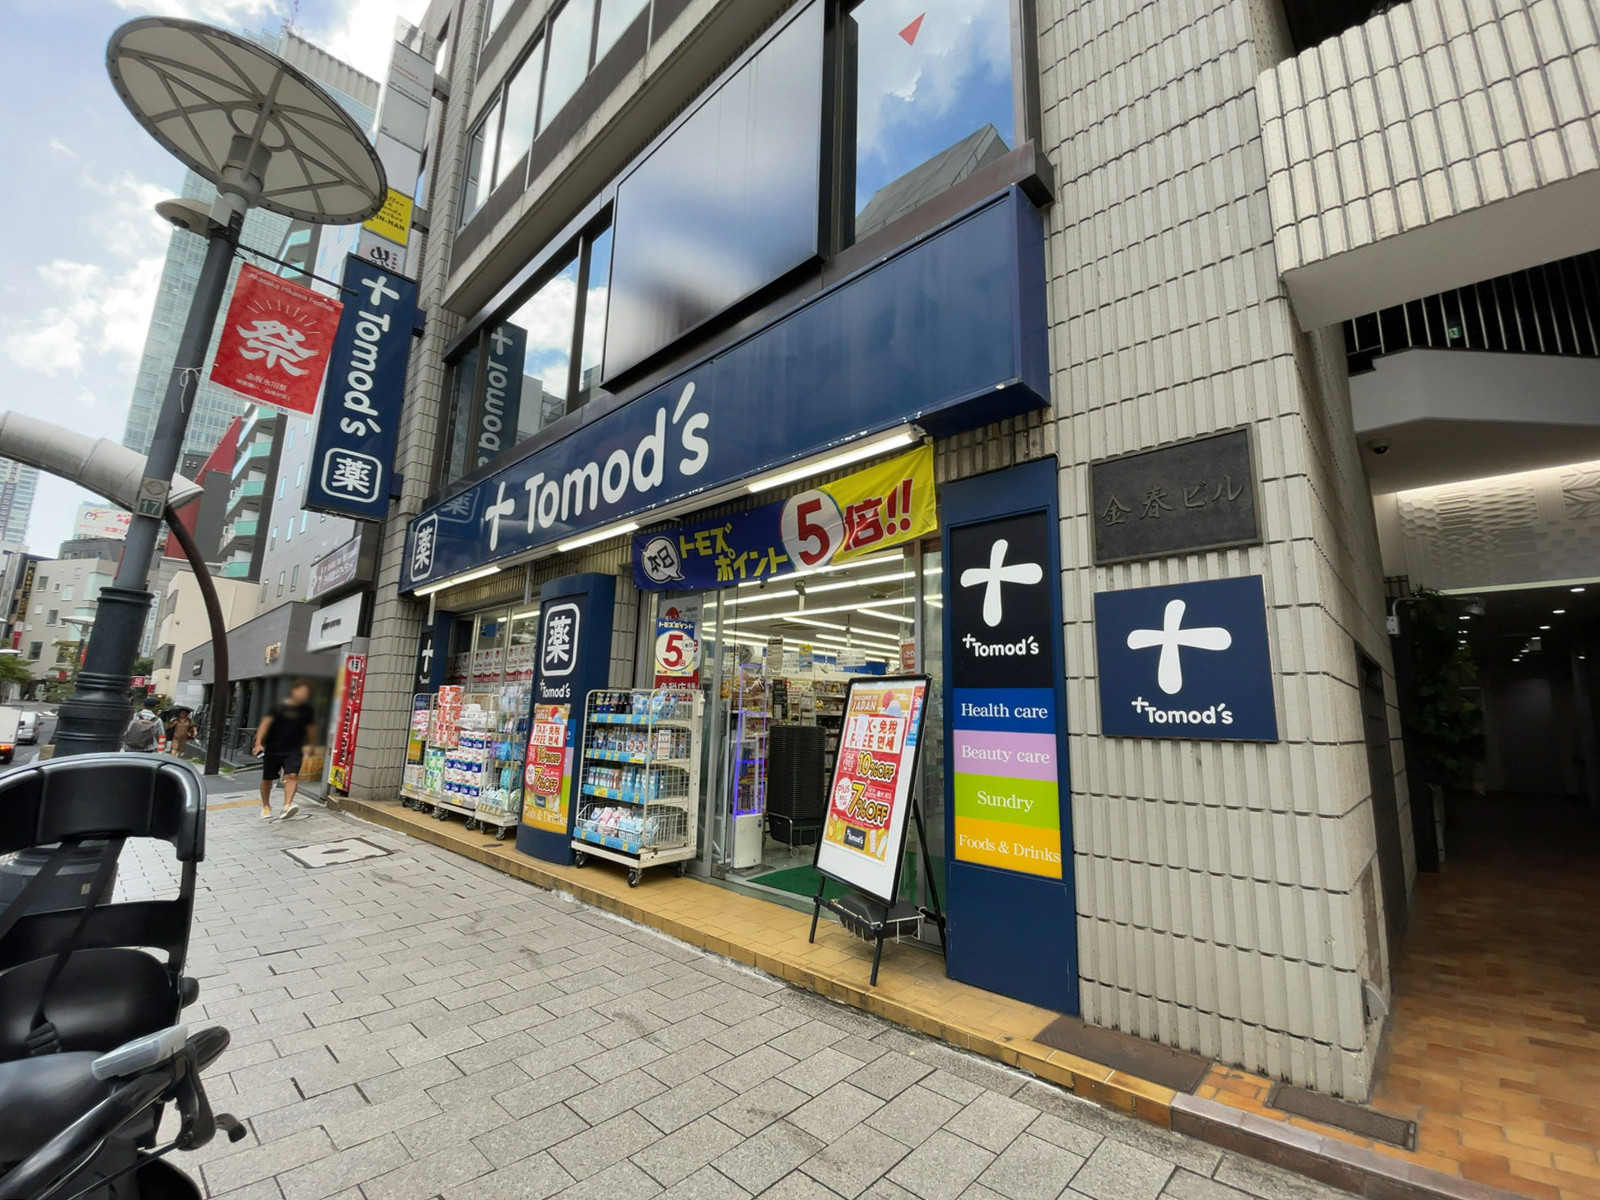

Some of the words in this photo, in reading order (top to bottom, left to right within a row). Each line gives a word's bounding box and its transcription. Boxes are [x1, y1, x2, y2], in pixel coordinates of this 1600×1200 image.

[236, 320, 320, 377] 祭
[340, 309, 391, 437] Tomod's
[525, 382, 710, 534] Tomod's
[332, 457, 373, 495] 薬
[142, 500, 160, 514] 17
[1102, 474, 1244, 527] 金春ビル
[414, 526, 433, 570] 薬
[680, 521, 732, 559] トモズ
[715, 547, 788, 582] ポイント
[546, 615, 572, 664] 薬
[973, 636, 1039, 657] Tomod's
[542, 682, 571, 698] Tomod's
[852, 701, 877, 711] JAPAN
[961, 703, 1009, 718] Health
[1014, 706, 1048, 719] care
[1145, 703, 1233, 725] Tomod's
[850, 733, 875, 748] FREE
[961, 744, 1012, 763] Beauty
[1017, 751, 1050, 765] care
[857, 752, 896, 780] 10%OFF
[847, 782, 889, 824] 7%OFF
[977, 791, 1034, 813] Sundry
[958, 834, 995, 852] Foods
[998, 840, 1009, 854] &
[1014, 842, 1061, 863] Drinks
